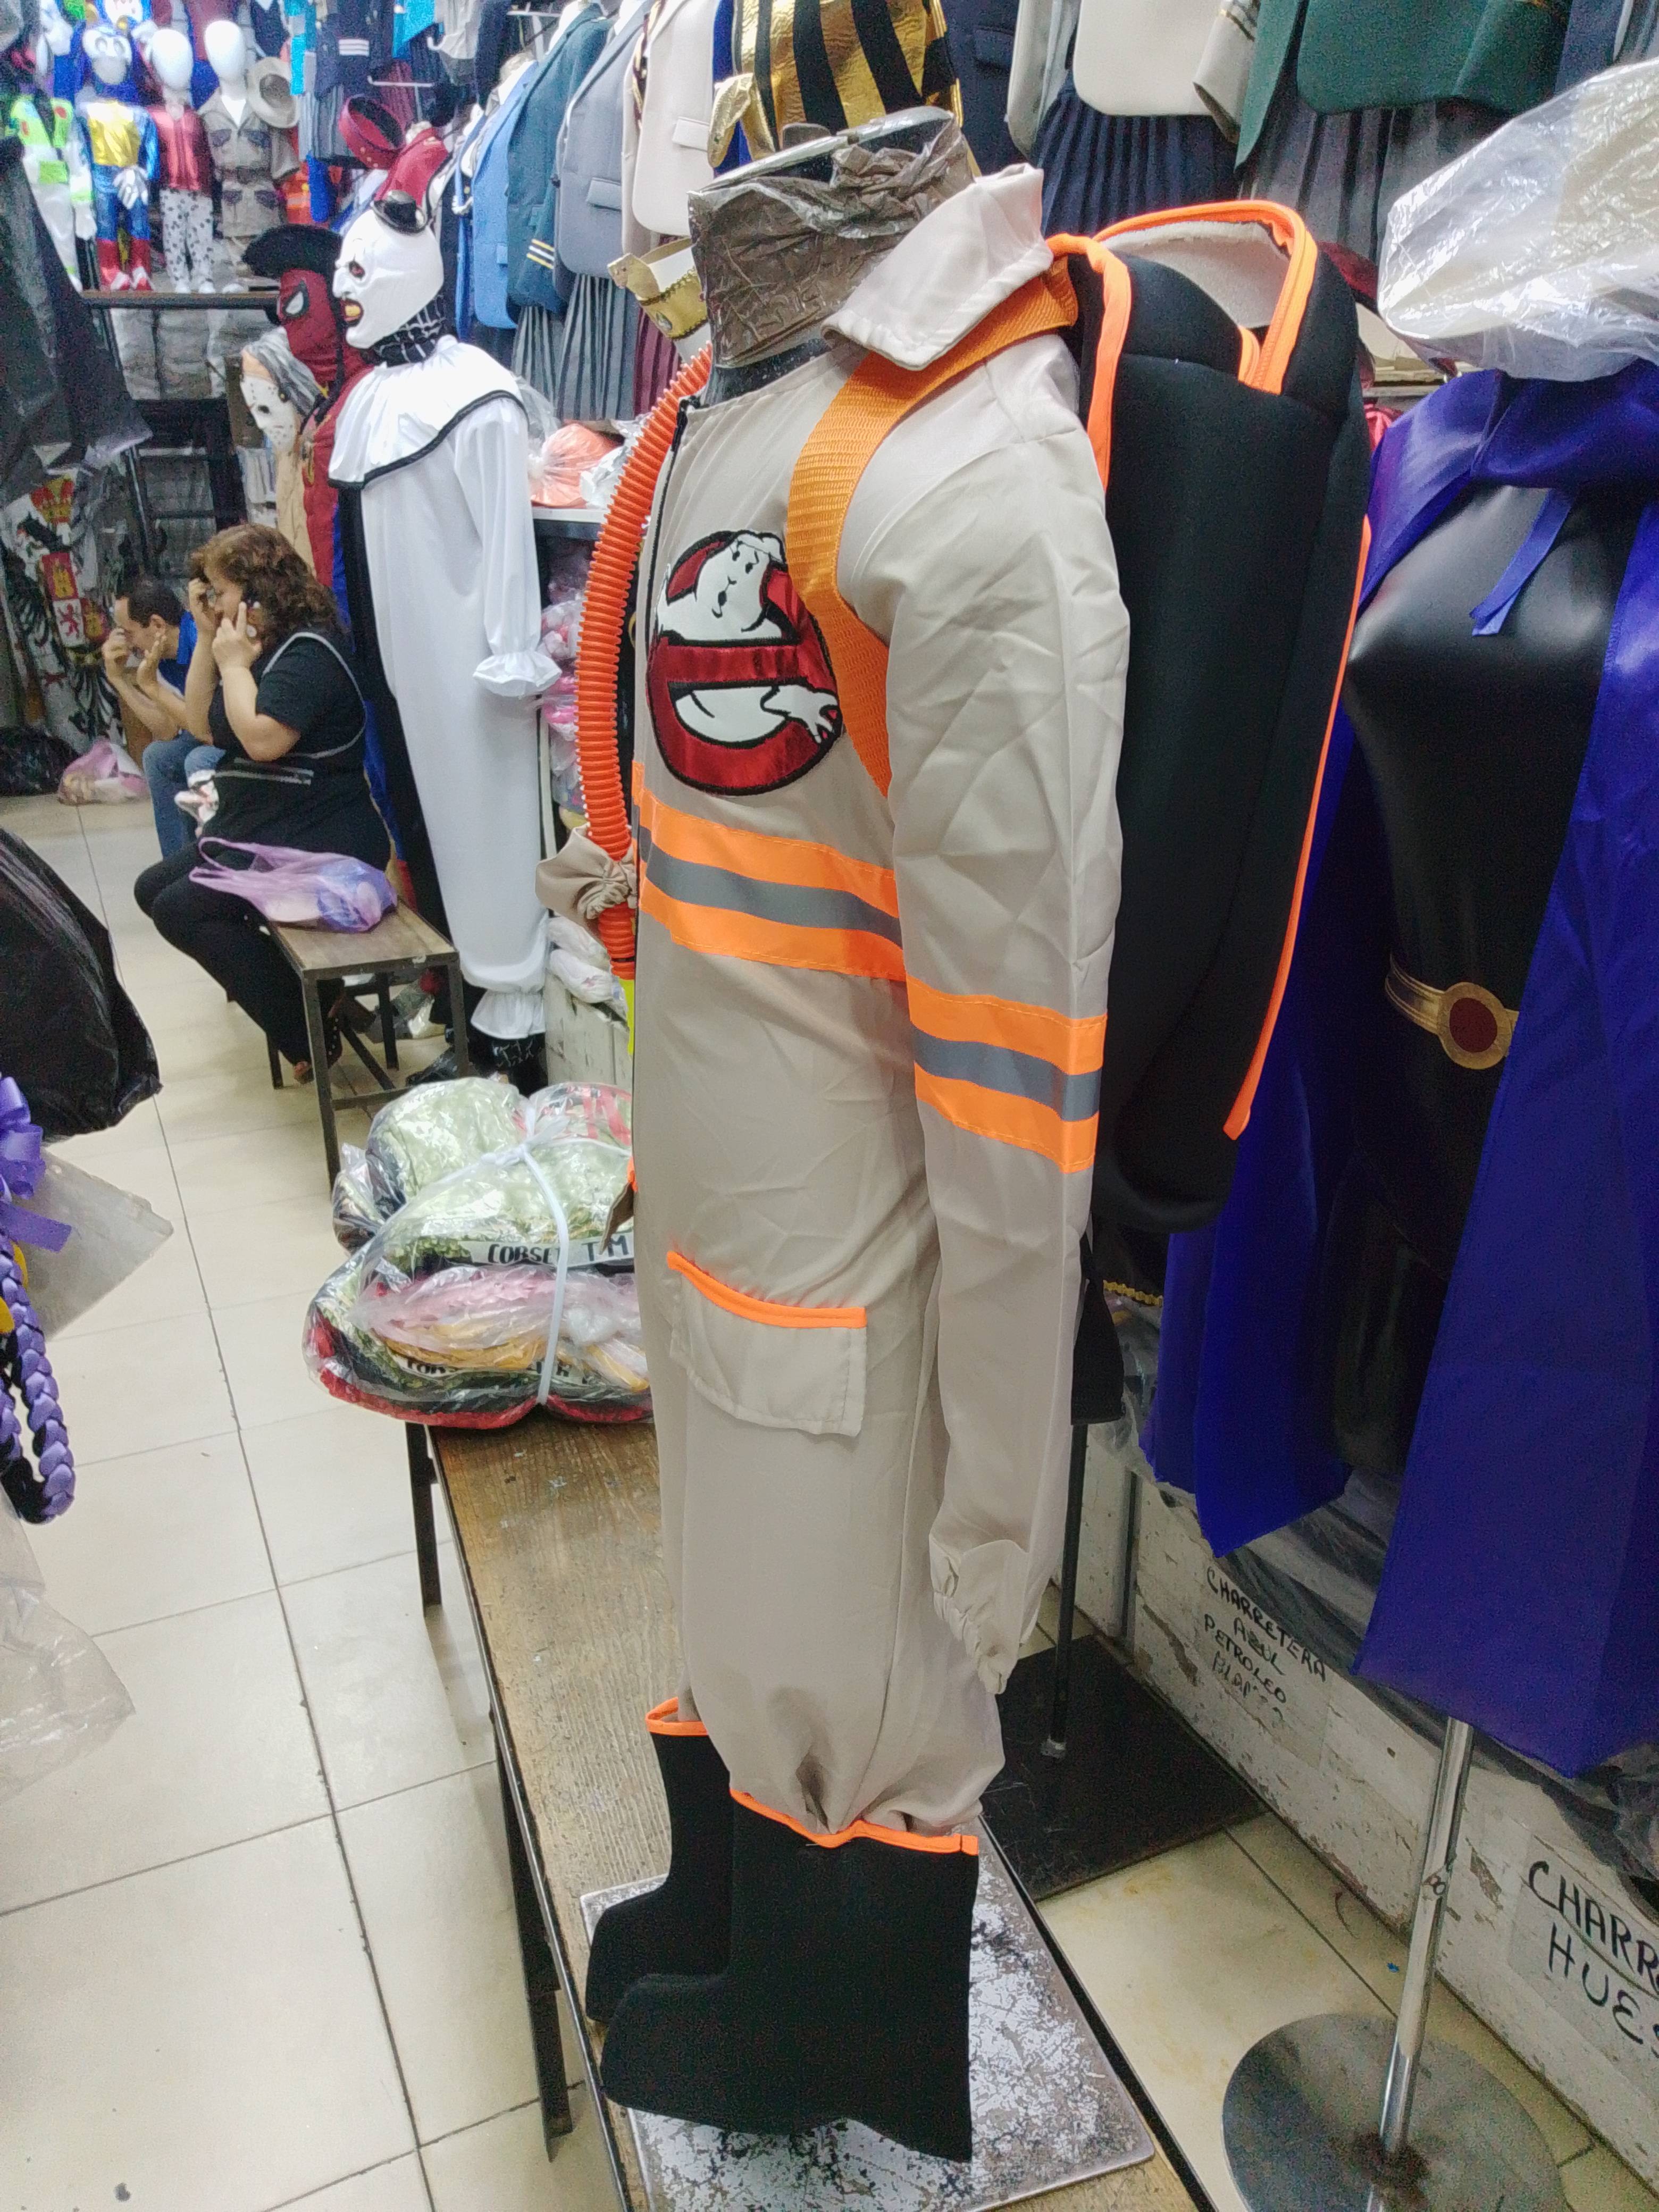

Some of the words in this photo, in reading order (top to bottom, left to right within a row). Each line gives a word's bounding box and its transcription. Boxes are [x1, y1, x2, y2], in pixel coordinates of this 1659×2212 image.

[1204, 1613, 1286, 1703] PETROLEO
[1206, 1566, 1326, 1682] CHARRETERA
[1528, 1861, 1659, 1995] CHARR
